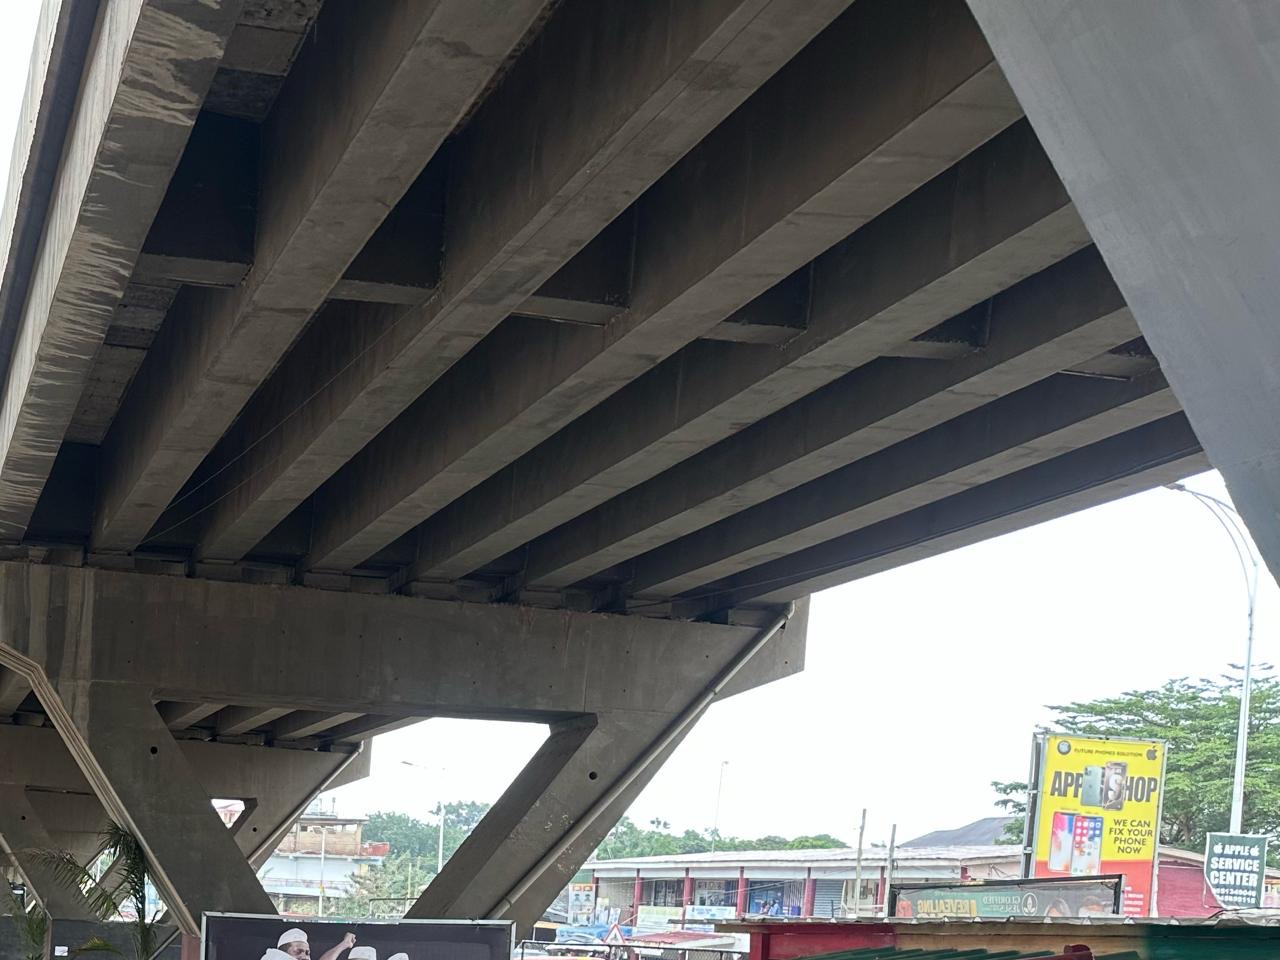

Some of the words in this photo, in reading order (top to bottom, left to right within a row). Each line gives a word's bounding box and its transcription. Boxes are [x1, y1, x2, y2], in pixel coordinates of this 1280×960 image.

[1113, 819, 1128, 827] WE
[1130, 820, 1150, 828] CAN
[1109, 828, 1123, 836] FIX
[1127, 829, 1153, 837] YOUR
[1114, 838, 1147, 846] PHONE
[1117, 846, 1142, 854] NOW
[1224, 845, 1249, 855] APPLE
[1210, 857, 1260, 872] SERVICE
[1210, 871, 1258, 887] CENTER
